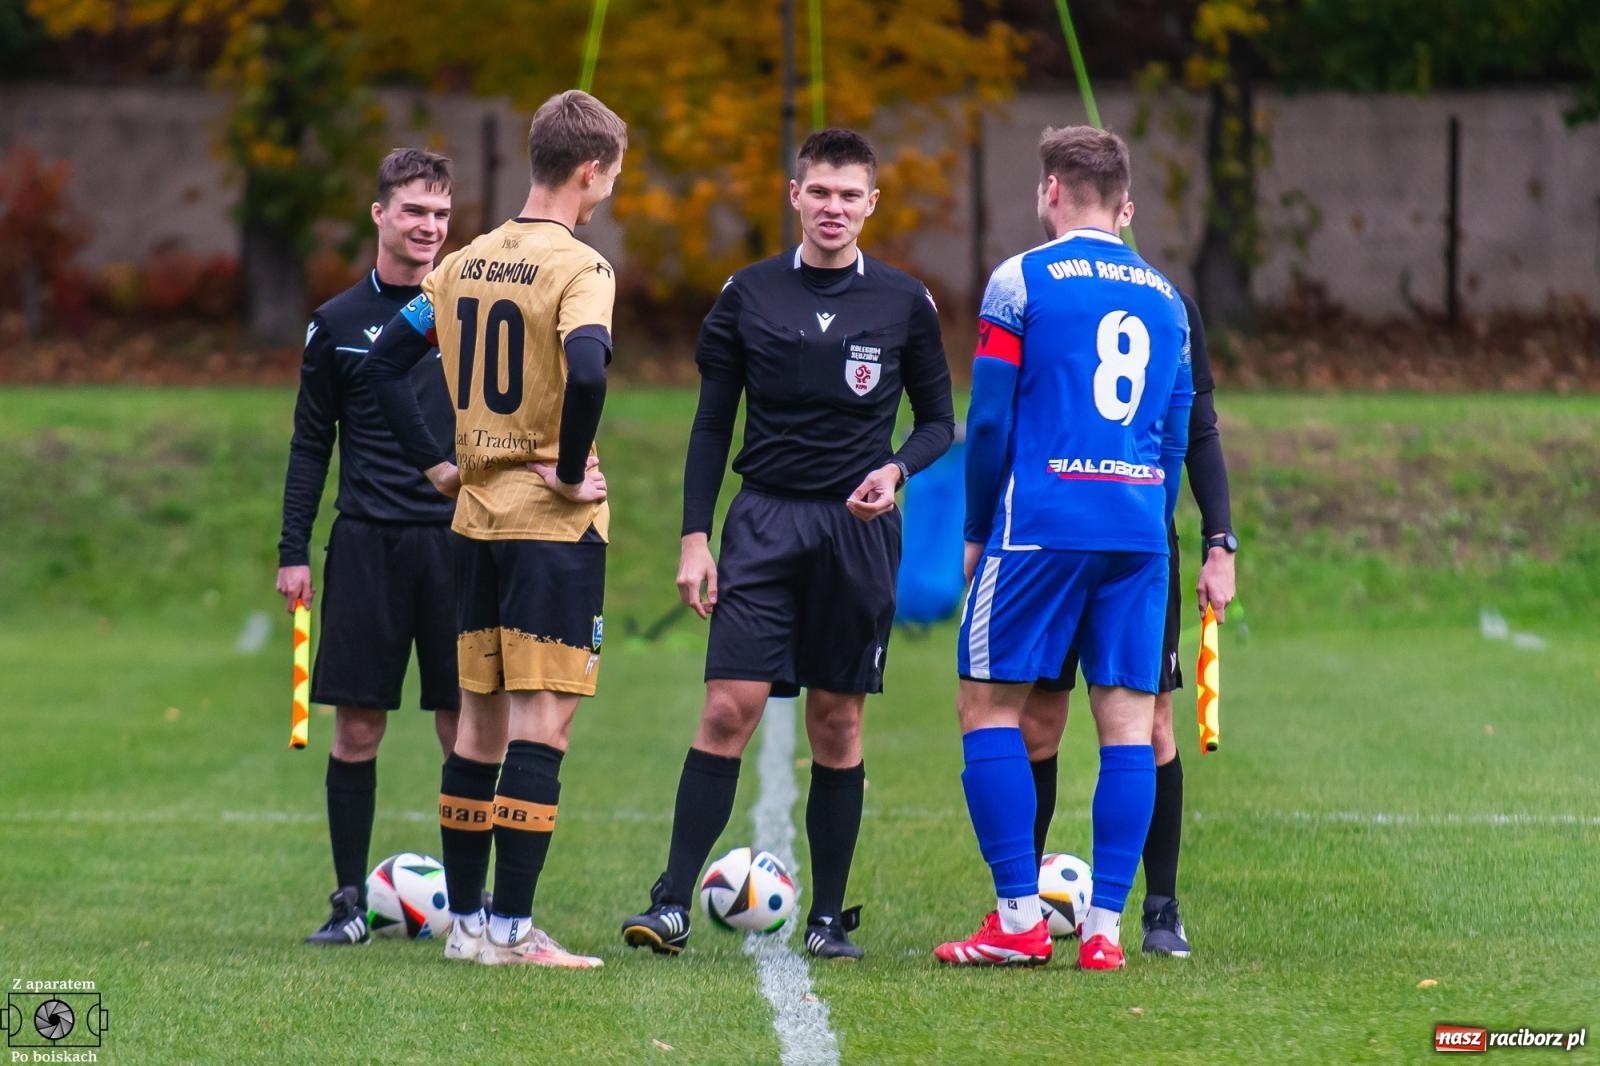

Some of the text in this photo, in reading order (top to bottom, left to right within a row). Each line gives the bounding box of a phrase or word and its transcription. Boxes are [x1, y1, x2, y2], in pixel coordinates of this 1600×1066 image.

[502, 239, 521, 249] 1936
[460, 258, 539, 285] LKS GAMÓW
[1047, 259, 1174, 299] UNIA RACIBÓRZ
[457, 296, 525, 415] 10
[1093, 309, 1151, 426] 8
[473, 429, 537, 453] Tradycji
